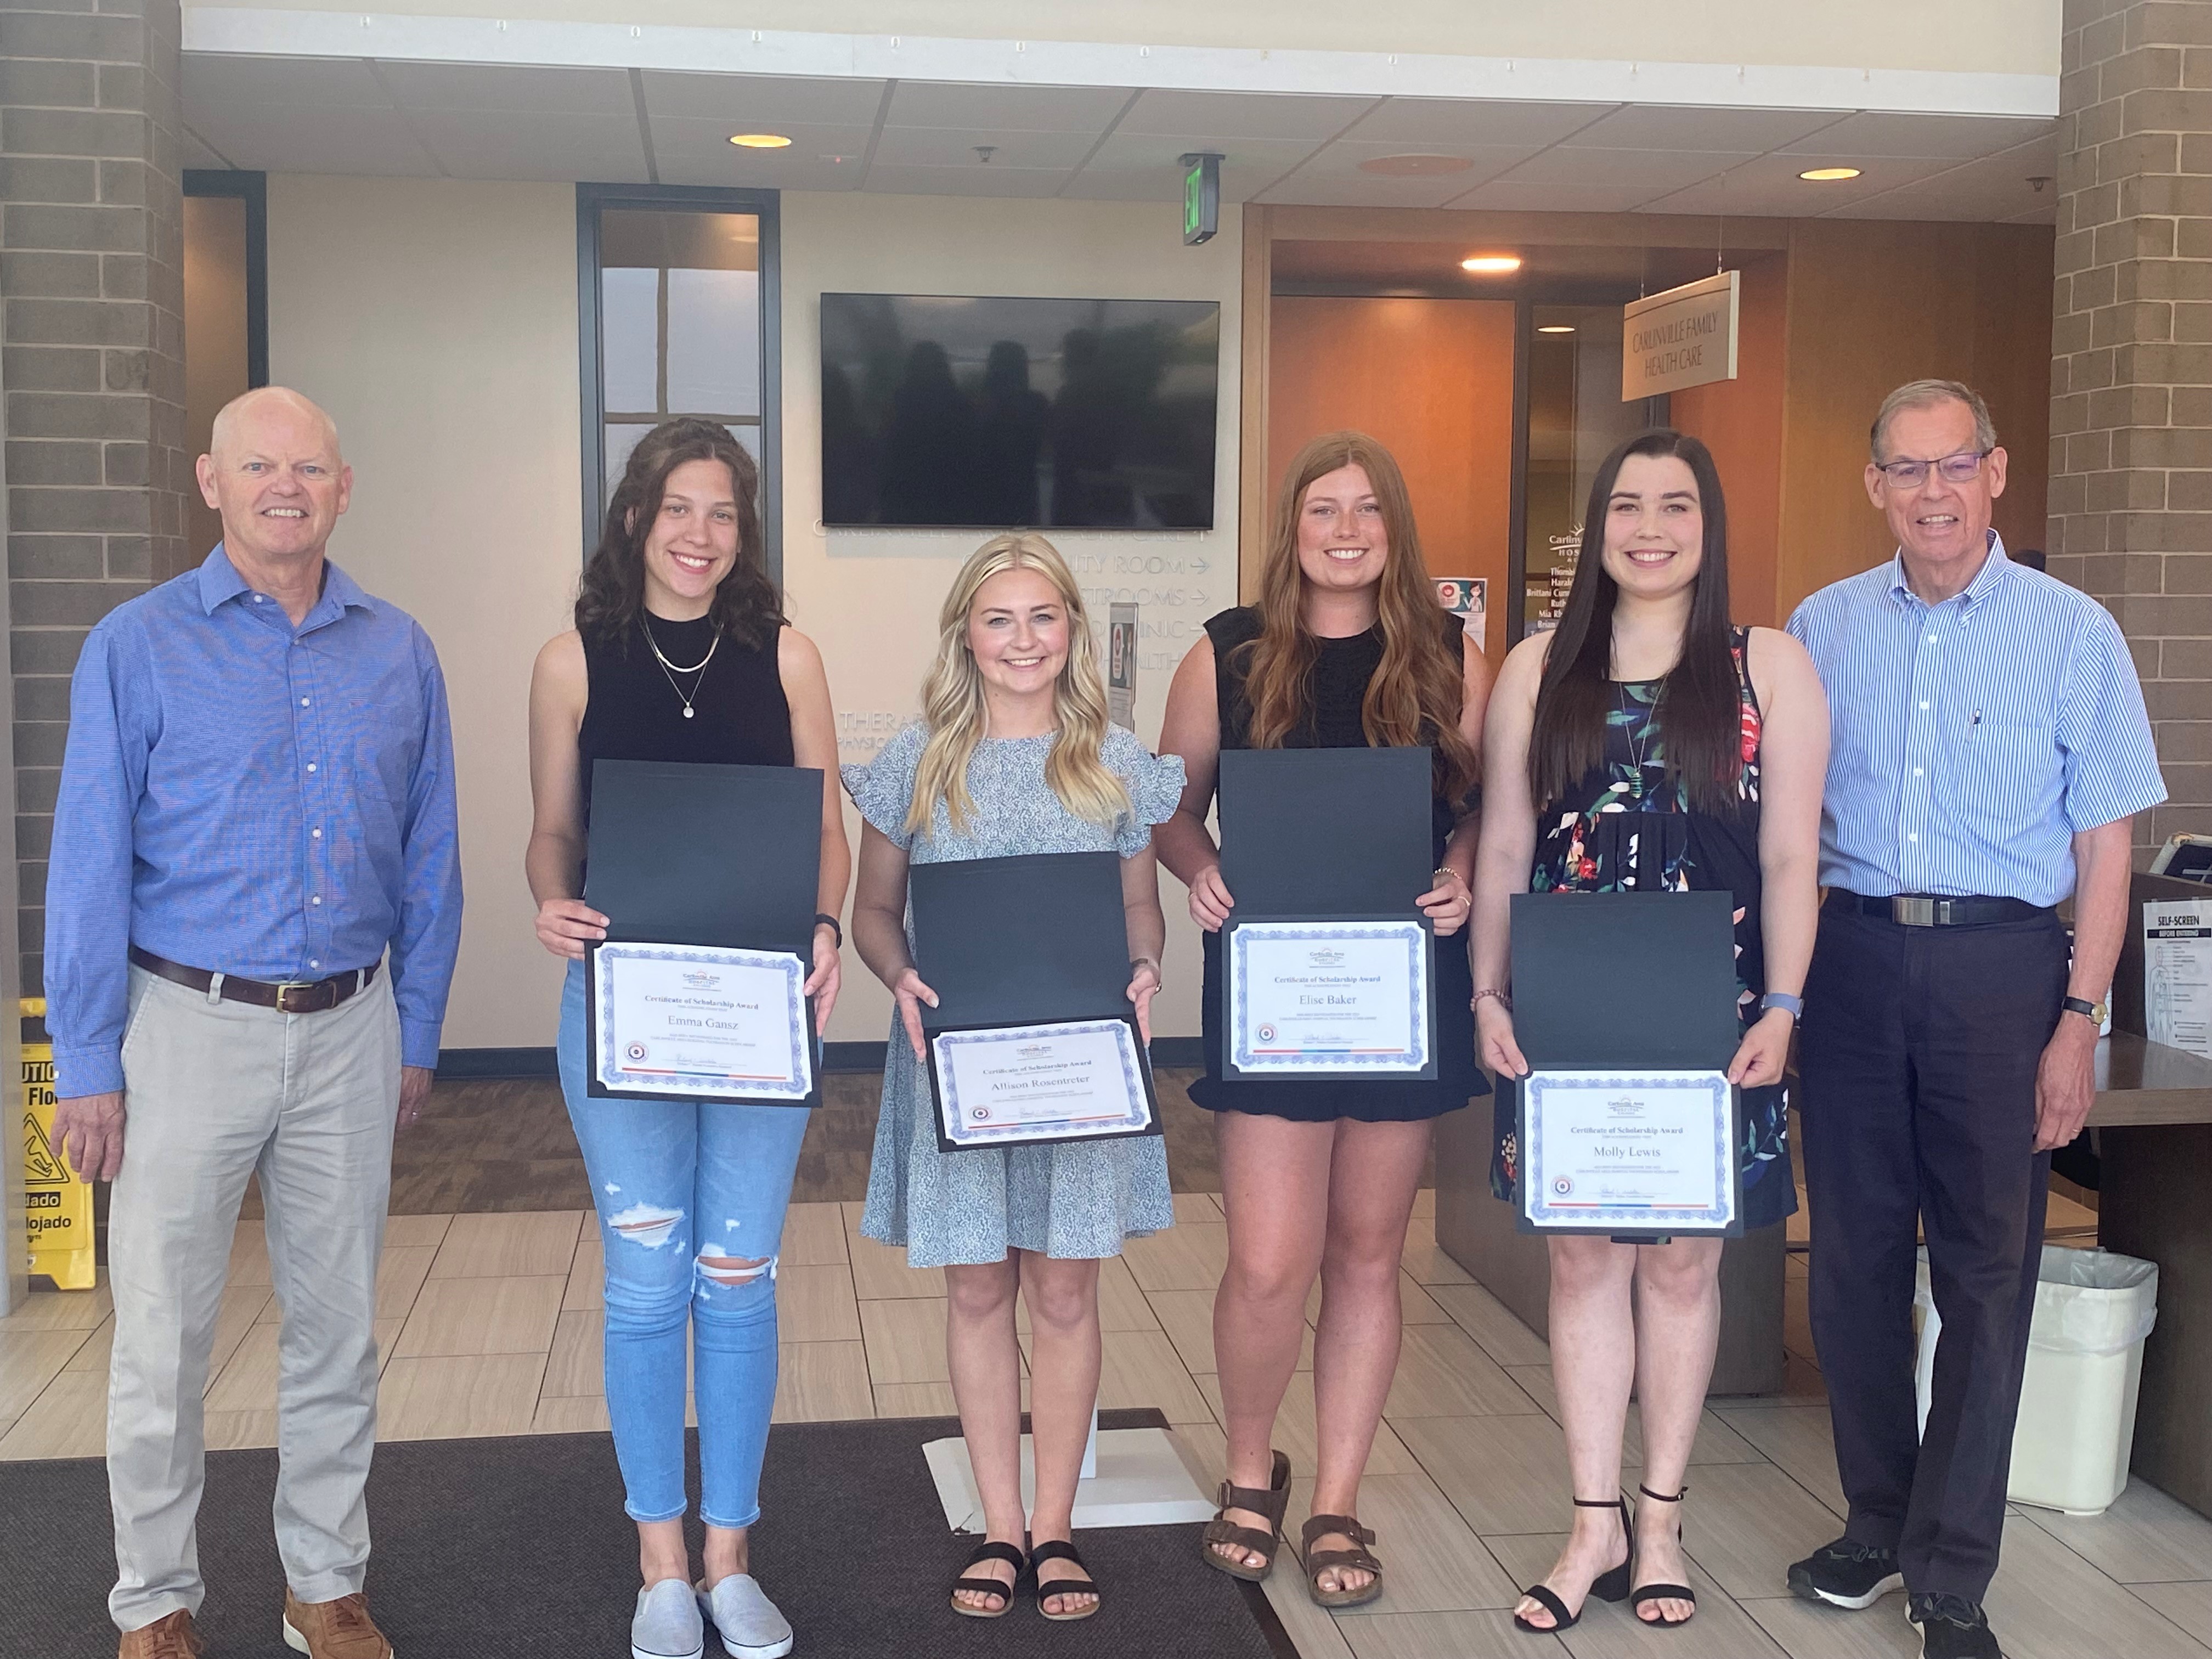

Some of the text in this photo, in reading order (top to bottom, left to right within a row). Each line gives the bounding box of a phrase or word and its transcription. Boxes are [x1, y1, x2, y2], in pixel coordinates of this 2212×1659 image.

[1633, 311, 1718, 353] CARLINVILLE FAMILY
[1645, 345, 1702, 379] HEALTH CARE
[1114, 555, 1184, 574] ROOM
[2158, 915, 2199, 926] SELF-SCREEN
[645, 995, 682, 1004] Certificate
[693, 998, 734, 1009] Scholarship
[1300, 995, 1357, 1005] Elise Baker
[668, 1015, 702, 1026] Emma
[1029, 1063, 1068, 1071] Scholarship
[991, 1080, 1028, 1091] Allison
[1618, 1127, 1658, 1135] Scholarship
[1594, 1146, 1661, 1159] Molly Lewis
